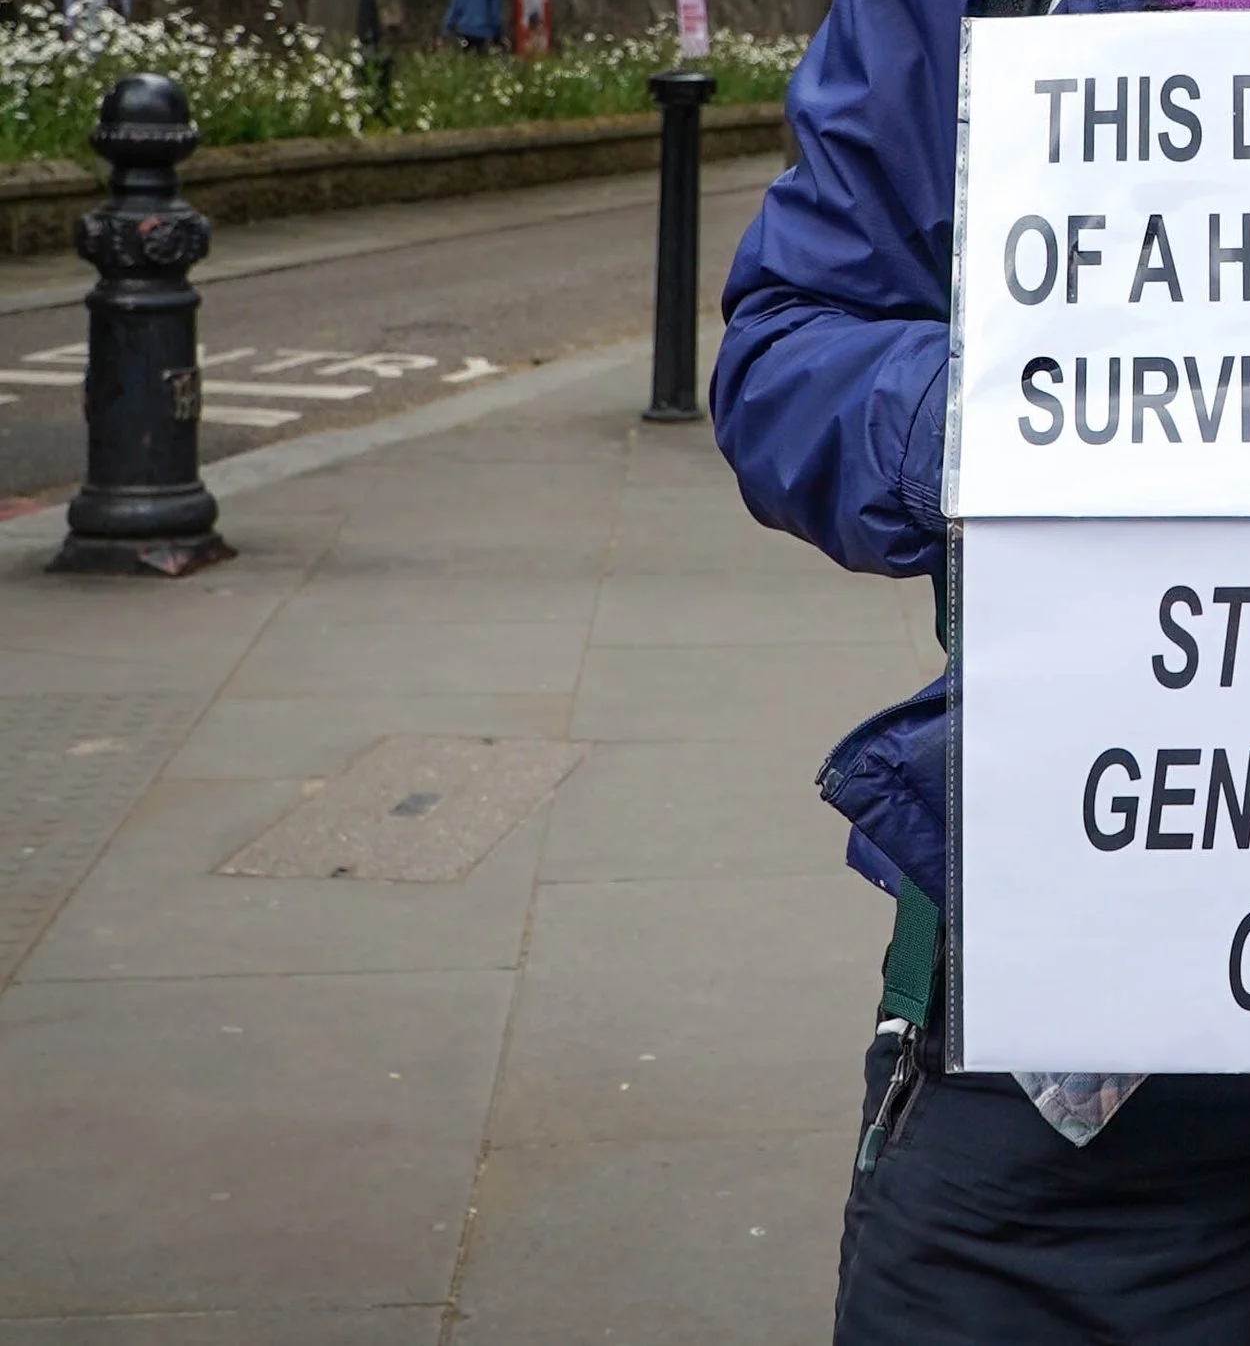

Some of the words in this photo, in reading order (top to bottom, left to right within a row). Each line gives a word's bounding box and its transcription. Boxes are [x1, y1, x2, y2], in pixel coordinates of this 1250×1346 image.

[1034, 75, 1203, 164] THIS
[1004, 214, 1106, 306] OF
[1128, 213, 1184, 303] A
